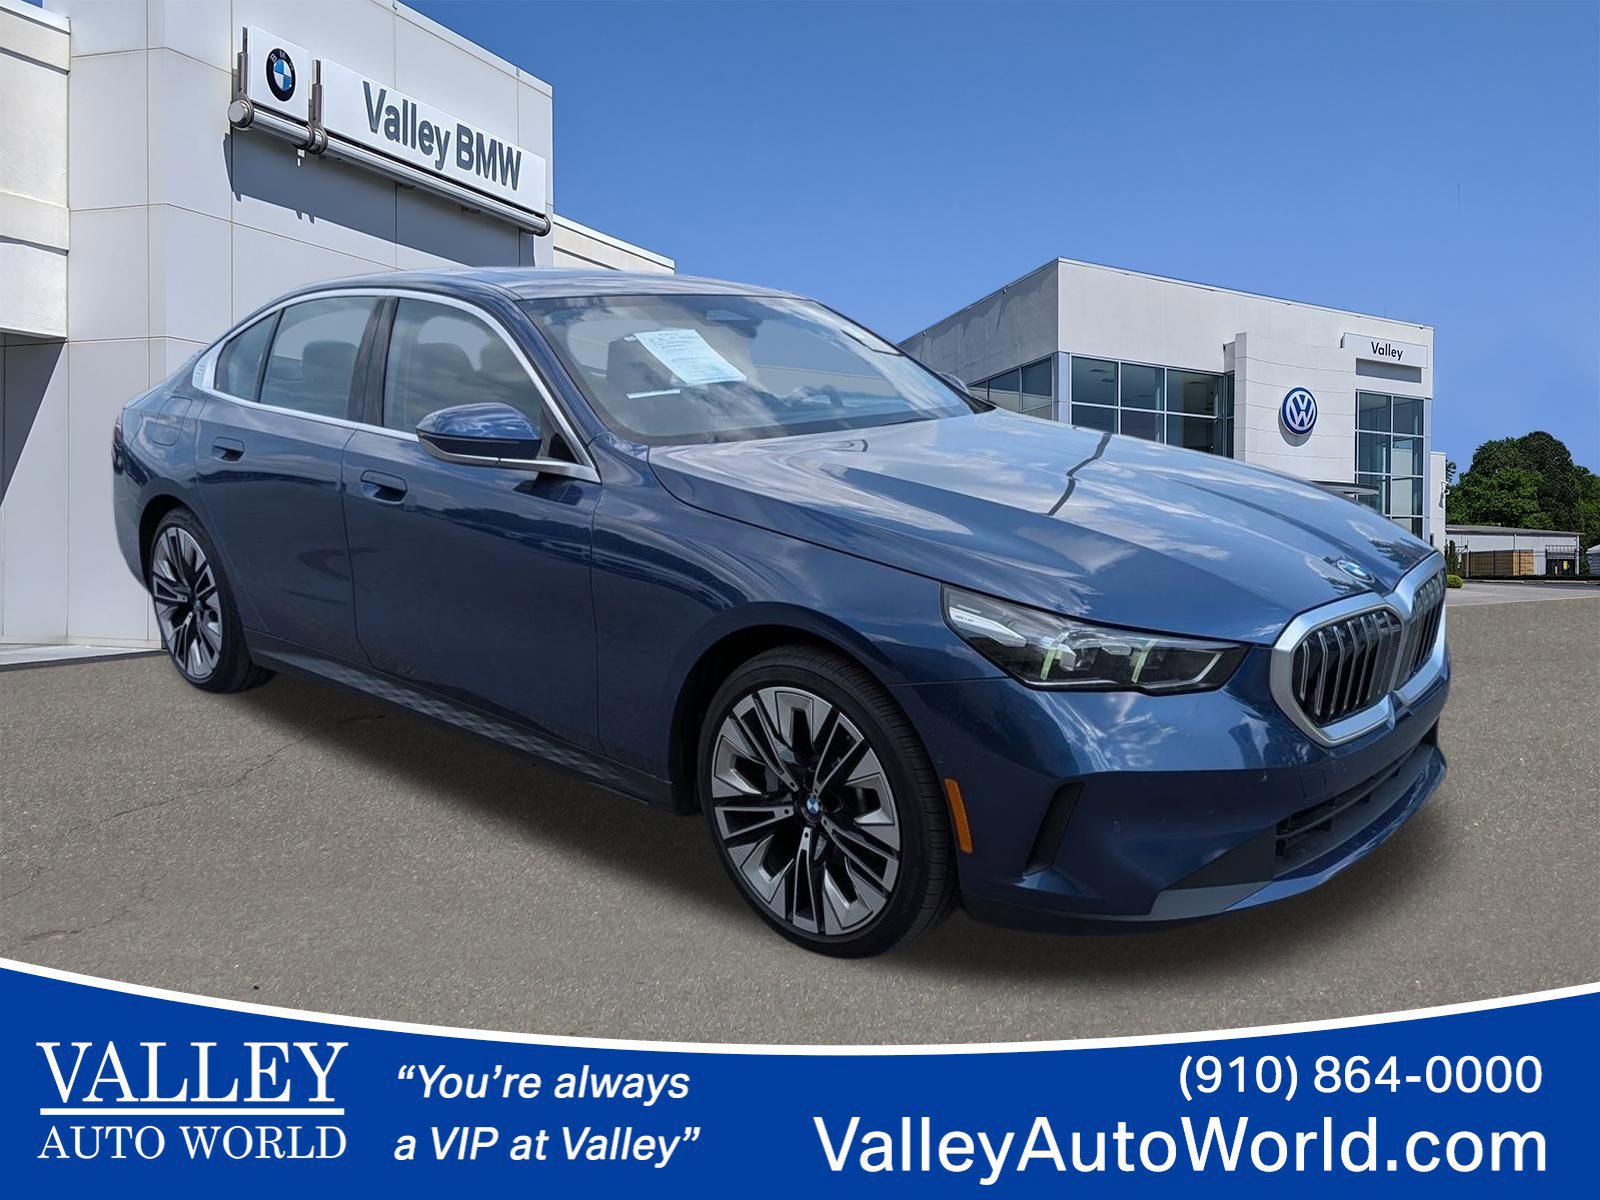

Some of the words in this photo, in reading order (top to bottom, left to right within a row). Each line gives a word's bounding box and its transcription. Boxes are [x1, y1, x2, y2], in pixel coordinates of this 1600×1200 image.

[362, 80, 450, 171] Valley
[456, 123, 522, 191] BMW
[1371, 341, 1403, 360] Valley
